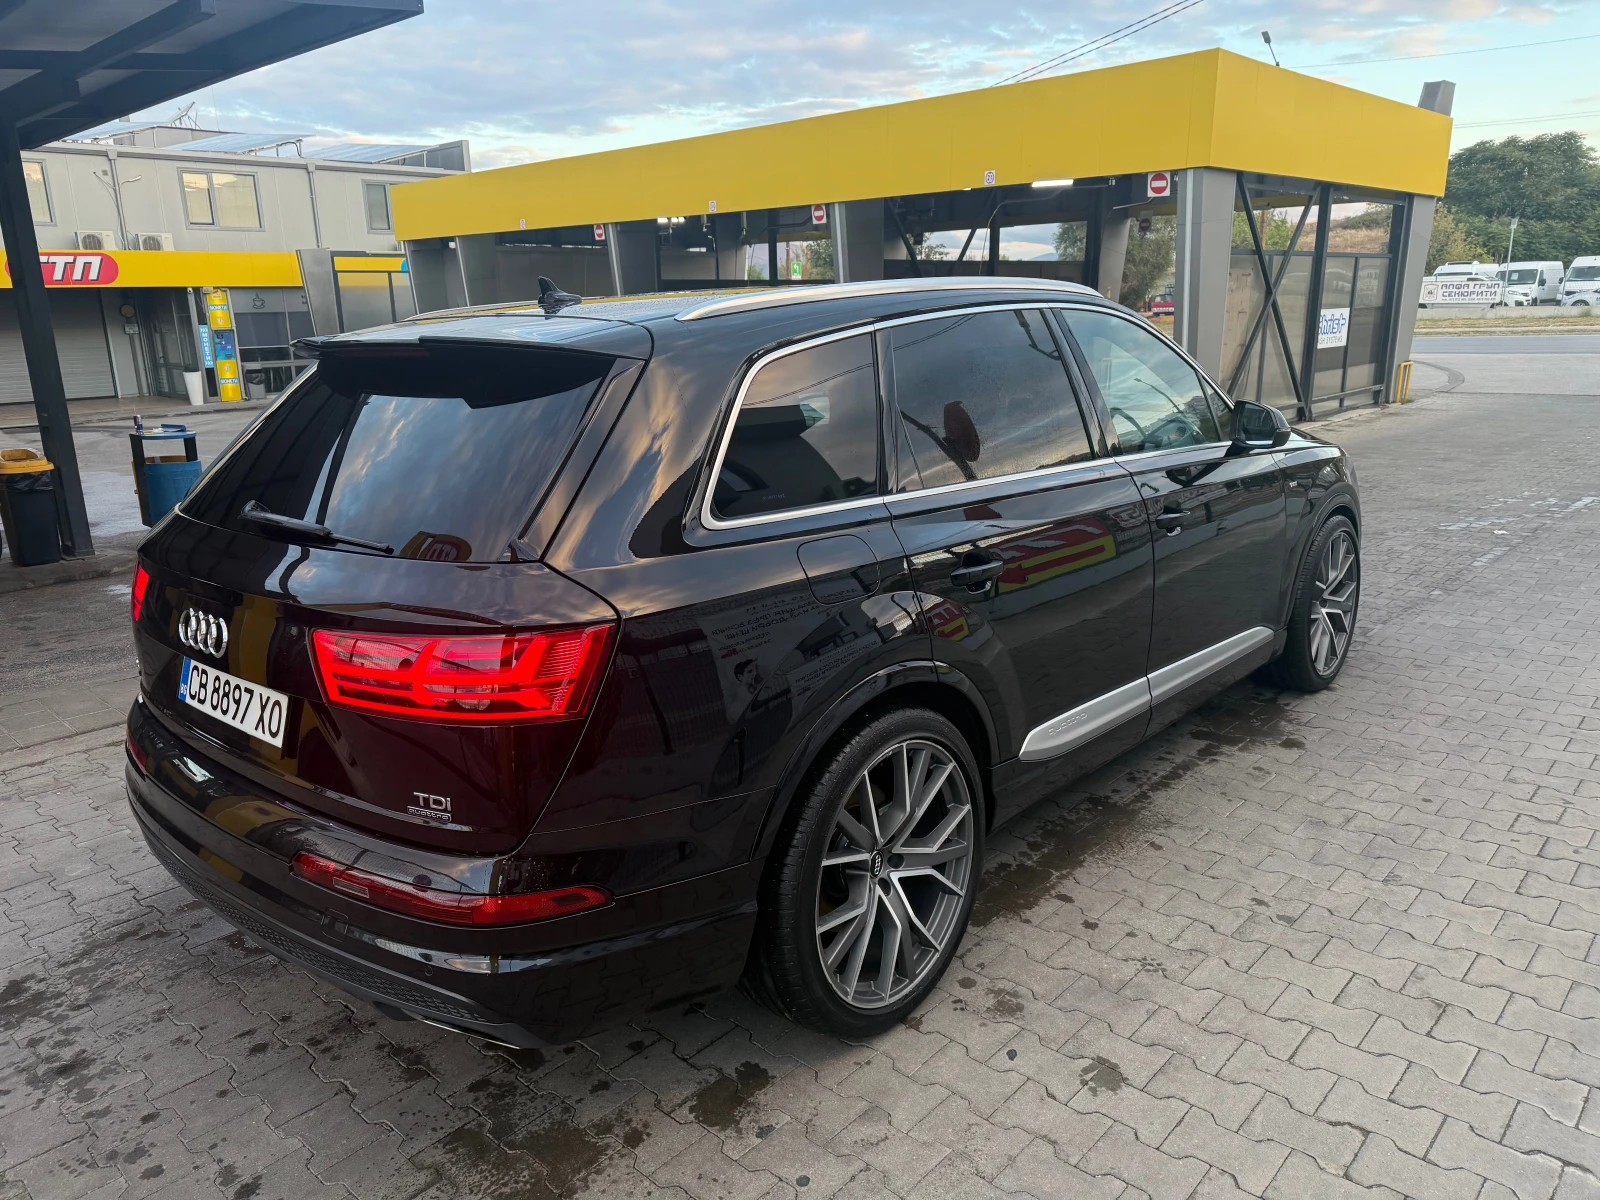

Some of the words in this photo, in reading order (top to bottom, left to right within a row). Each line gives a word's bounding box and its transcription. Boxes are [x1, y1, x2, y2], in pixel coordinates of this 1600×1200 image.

[202, 333, 211, 360] МОНЕТИ
[189, 665, 209, 705] CB
[211, 675, 255, 725] 8897
[255, 692, 283, 738] XO
[413, 791, 452, 811] TDI
[408, 808, 449, 820] quattro
